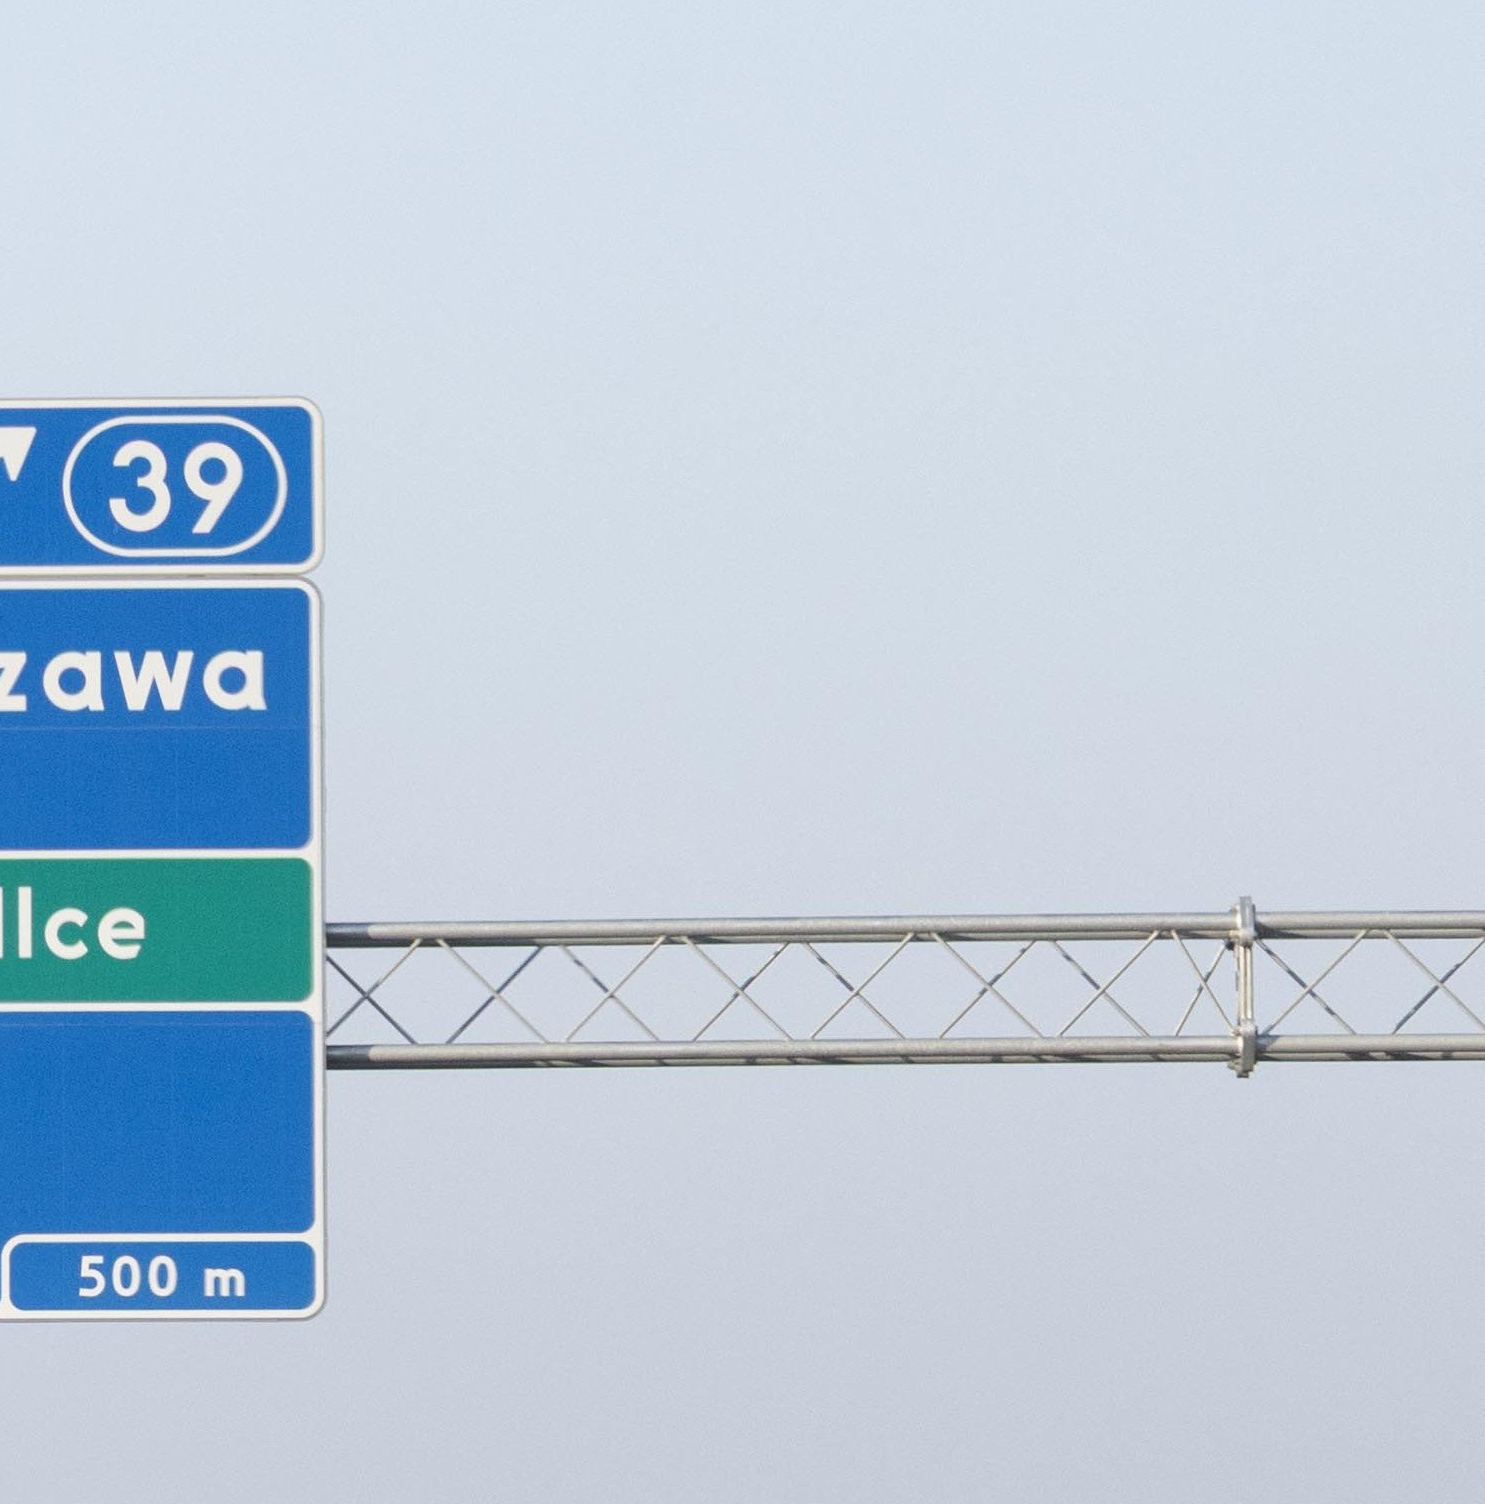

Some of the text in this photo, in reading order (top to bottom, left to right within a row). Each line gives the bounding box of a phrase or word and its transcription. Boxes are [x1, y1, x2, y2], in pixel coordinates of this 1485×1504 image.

[108, 440, 245, 534] 39
[78, 1255, 246, 1298] 500 m
